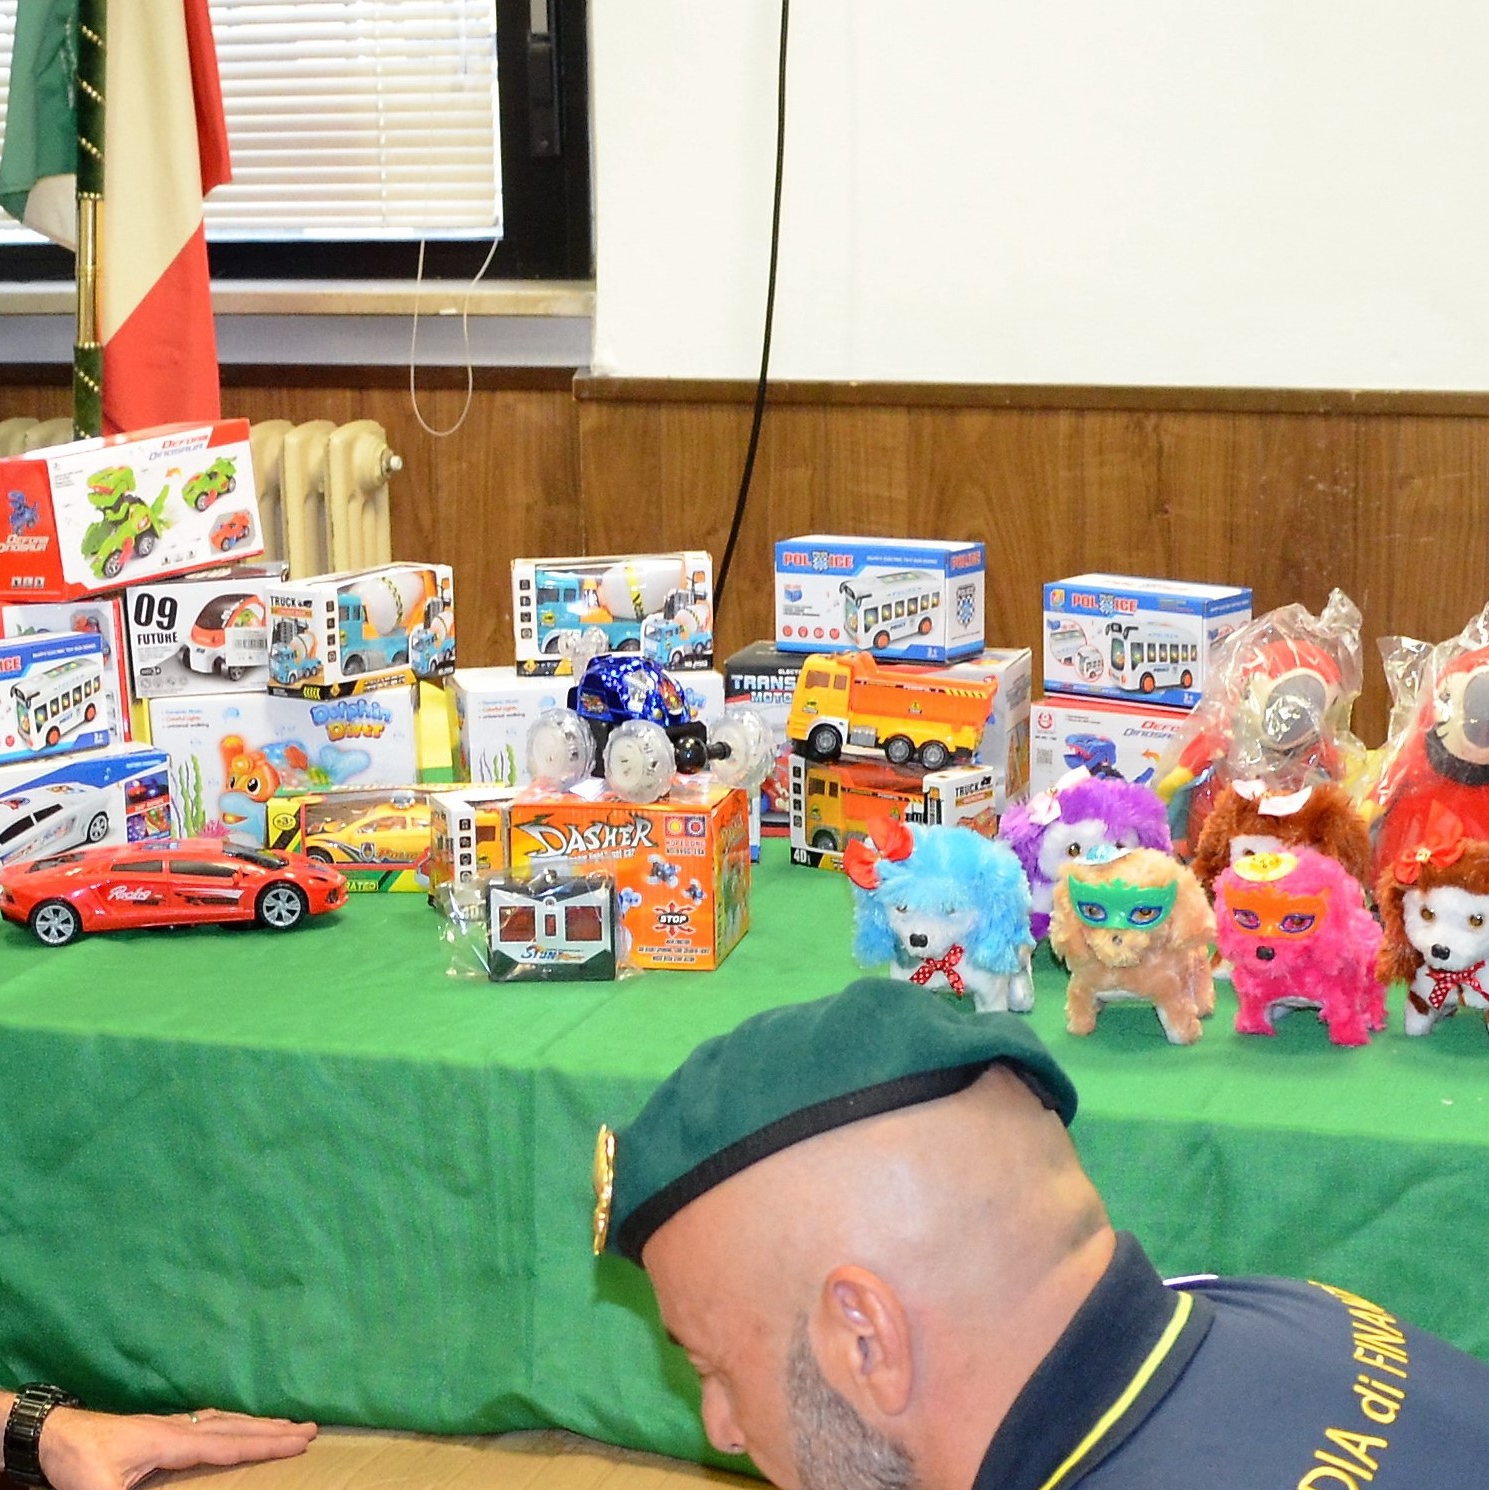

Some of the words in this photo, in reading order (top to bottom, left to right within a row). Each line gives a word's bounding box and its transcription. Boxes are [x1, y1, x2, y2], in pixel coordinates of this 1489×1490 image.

[270, 595, 297, 607] TRUCK
[133, 592, 179, 631] 09
[730, 674, 796, 690] TRANS
[750, 691, 792, 703] MOTO
[310, 700, 393, 727] Dolphin
[955, 781, 980, 796] TRUCK
[516, 813, 659, 861] DASHER
[660, 914, 688, 924] STOP
[1352, 1374, 1406, 1425] di
